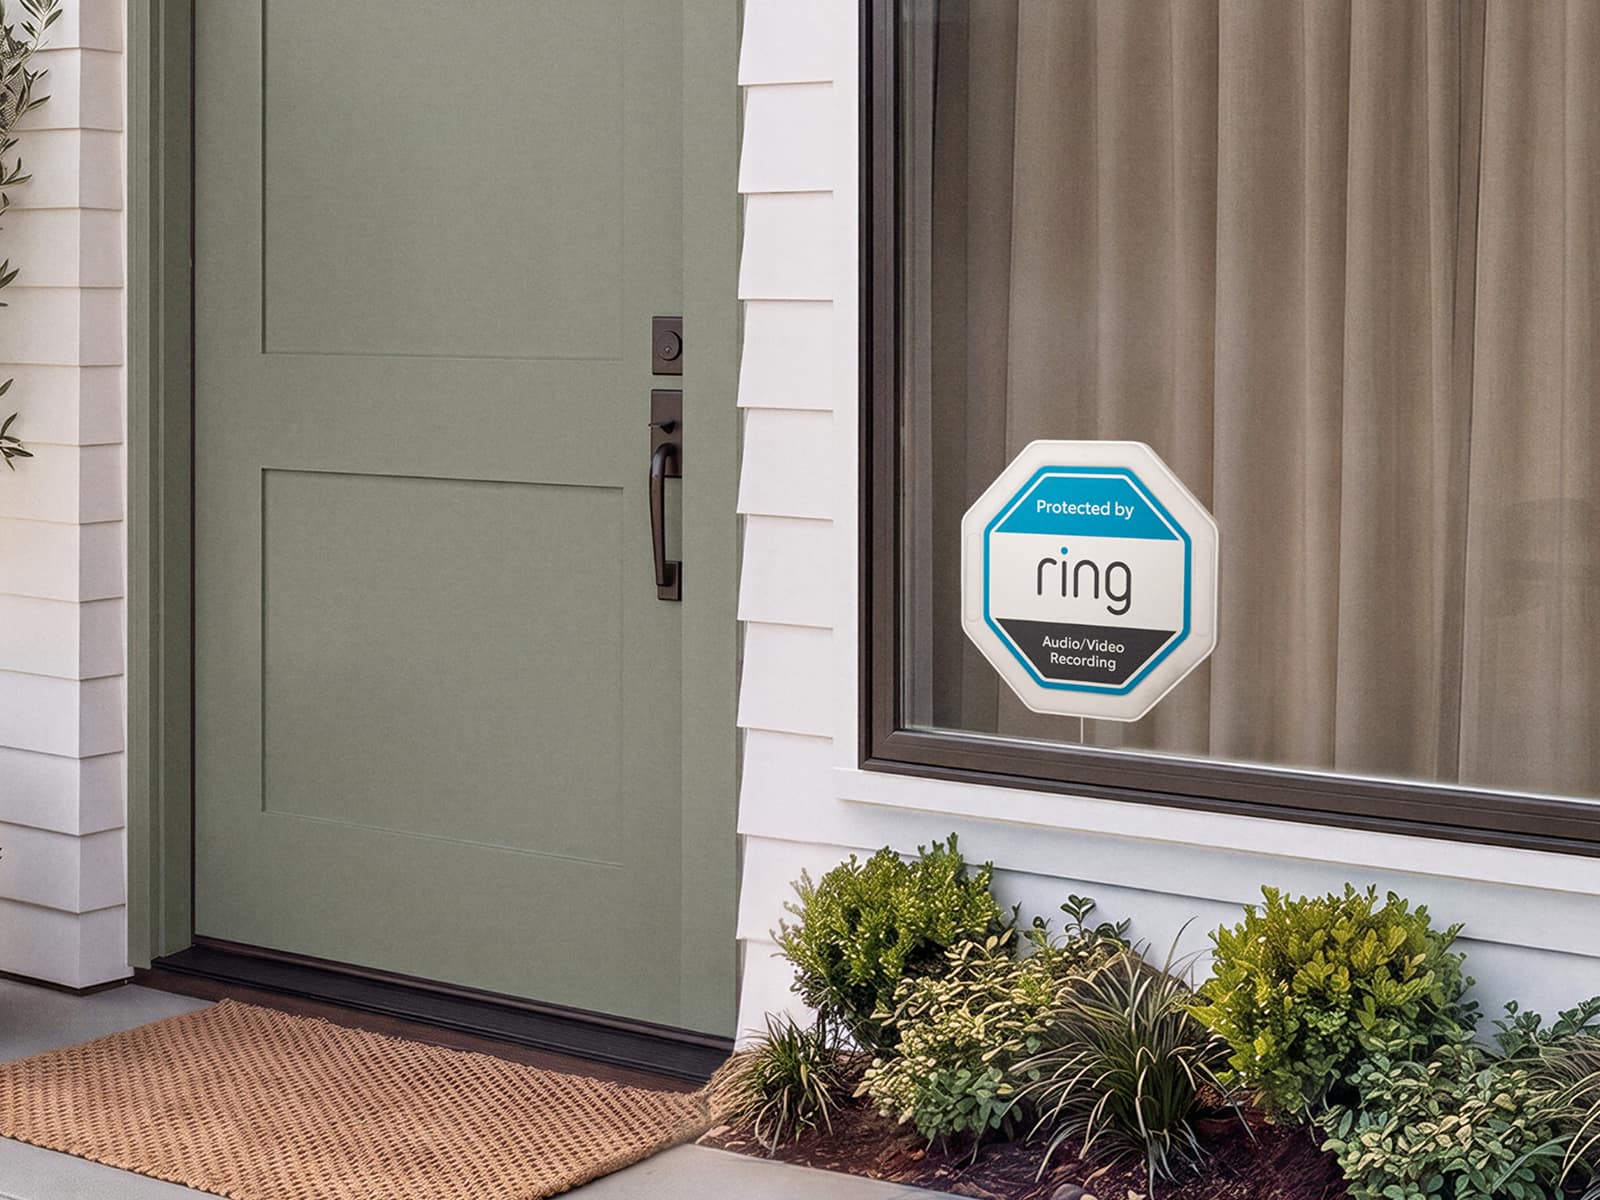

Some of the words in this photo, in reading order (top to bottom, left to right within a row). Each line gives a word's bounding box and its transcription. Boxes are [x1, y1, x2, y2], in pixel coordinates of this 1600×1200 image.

[1036, 500, 1111, 516] Protected
[1114, 501, 1135, 520] by
[1037, 546, 1132, 616] ring
[1042, 636, 1125, 654] Audio/Video
[1050, 652, 1117, 671] Recording
